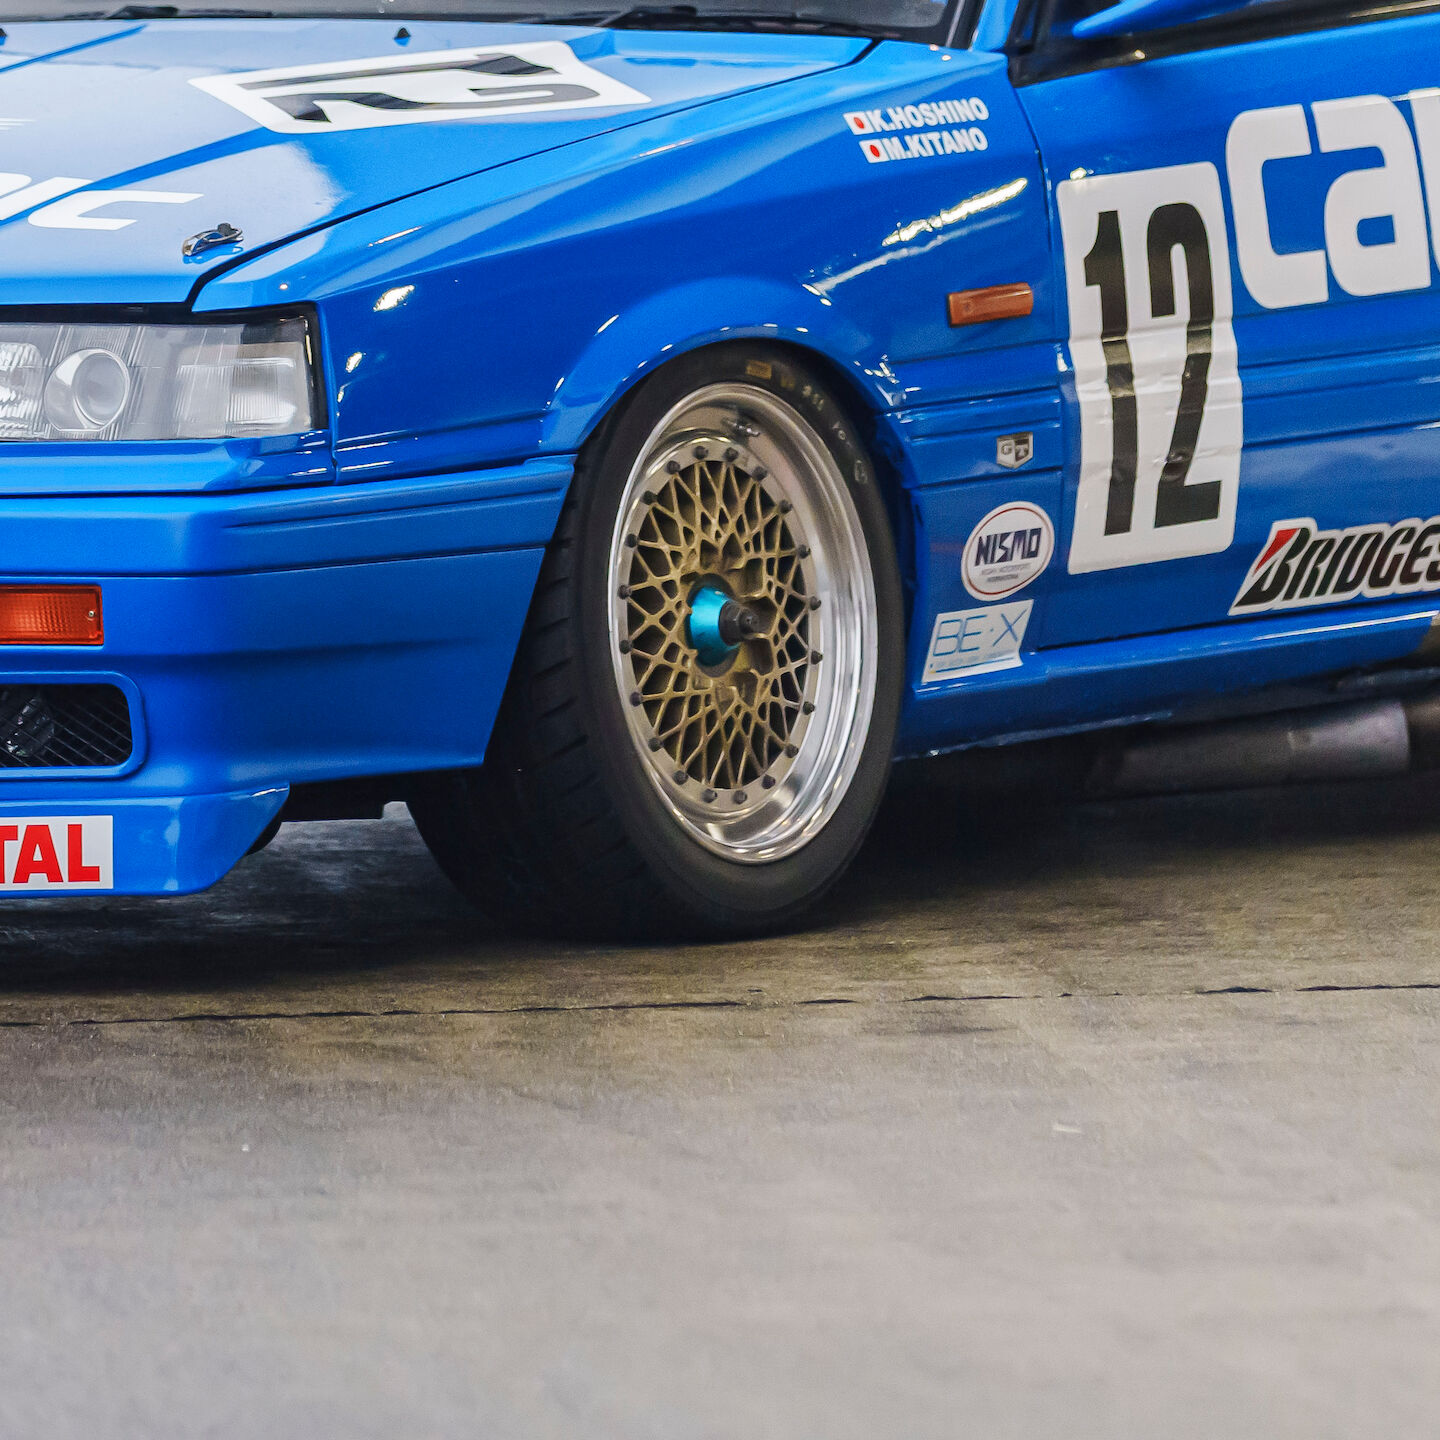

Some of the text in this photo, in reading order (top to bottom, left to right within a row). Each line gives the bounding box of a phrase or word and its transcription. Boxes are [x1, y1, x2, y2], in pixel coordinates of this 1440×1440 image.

[866, 96, 990, 132] K.HOSHINO
[881, 126, 989, 160] M.KITANO
[1082, 201, 1223, 537] 12
[974, 527, 1043, 568] NISMO
